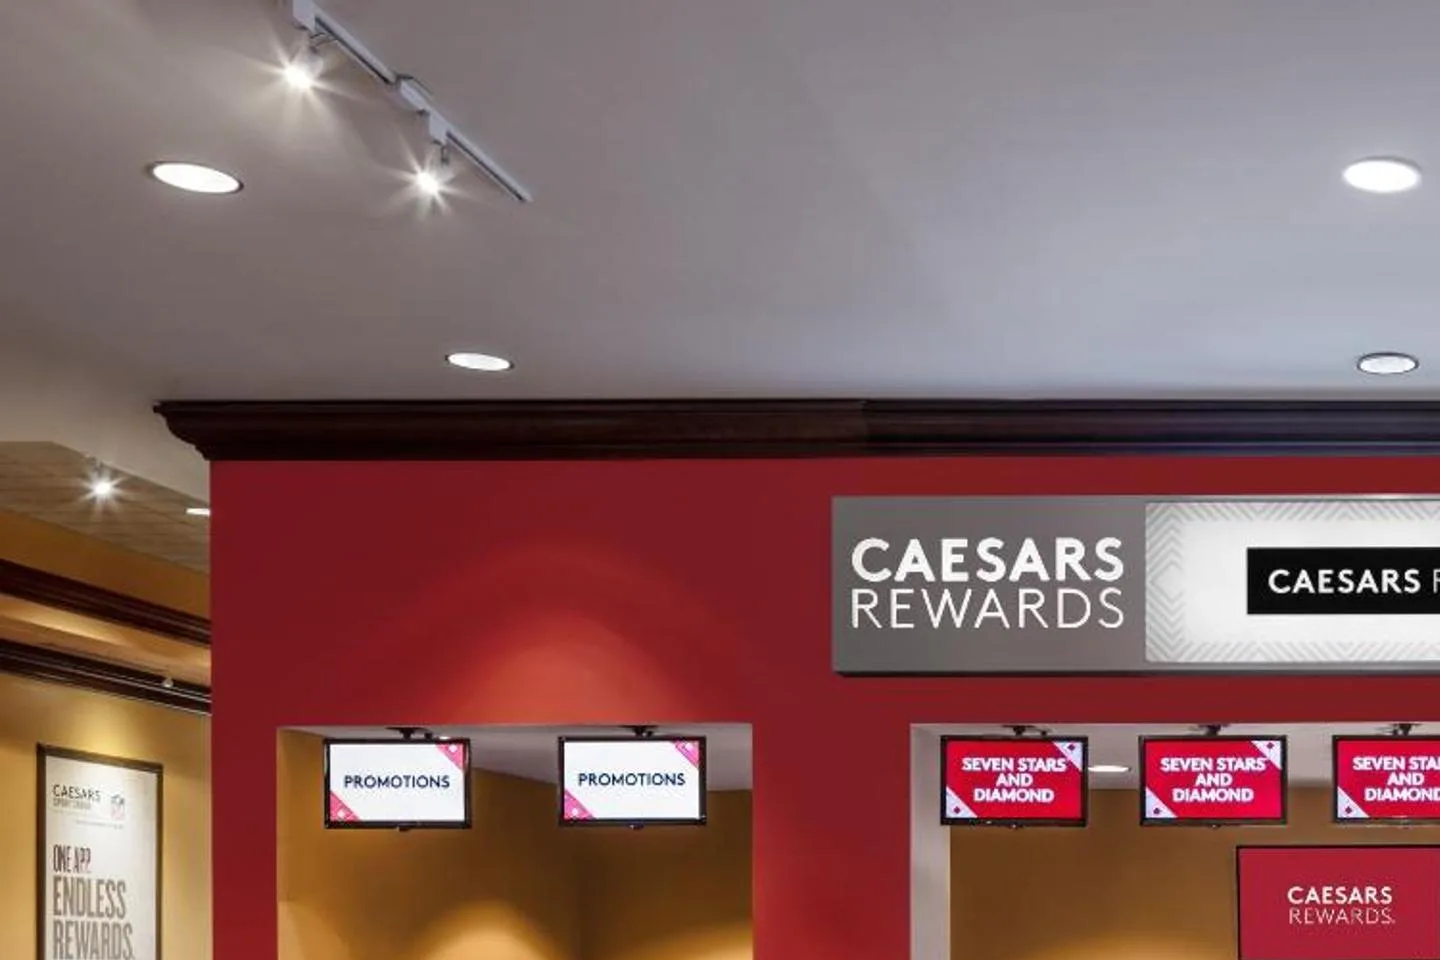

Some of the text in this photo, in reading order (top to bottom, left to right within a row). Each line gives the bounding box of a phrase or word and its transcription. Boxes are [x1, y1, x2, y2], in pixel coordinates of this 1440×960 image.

[851, 536, 1124, 582] CAESARS
[1268, 568, 1421, 595] CAESARS
[851, 587, 1124, 629] REWARDS
[961, 757, 1067, 772] SEVEN STARS
[1160, 757, 1266, 772] SEVEN STARS
[1352, 756, 1405, 771] SEVEN
[344, 774, 450, 789] PROMOTIONS
[578, 772, 686, 787] PROMOTIONS
[996, 772, 1034, 787] AND
[1195, 772, 1233, 787] AND
[1387, 771, 1425, 786] AND
[52, 784, 101, 801] CAESARS
[973, 788, 1055, 802] DIAMOND
[1172, 788, 1254, 802] DIAMOND
[53, 844, 72, 873] ONE
[53, 876, 127, 920] ENDLESS
[1287, 886, 1393, 905] CAESARS
[53, 919, 135, 960] REWARDS.
